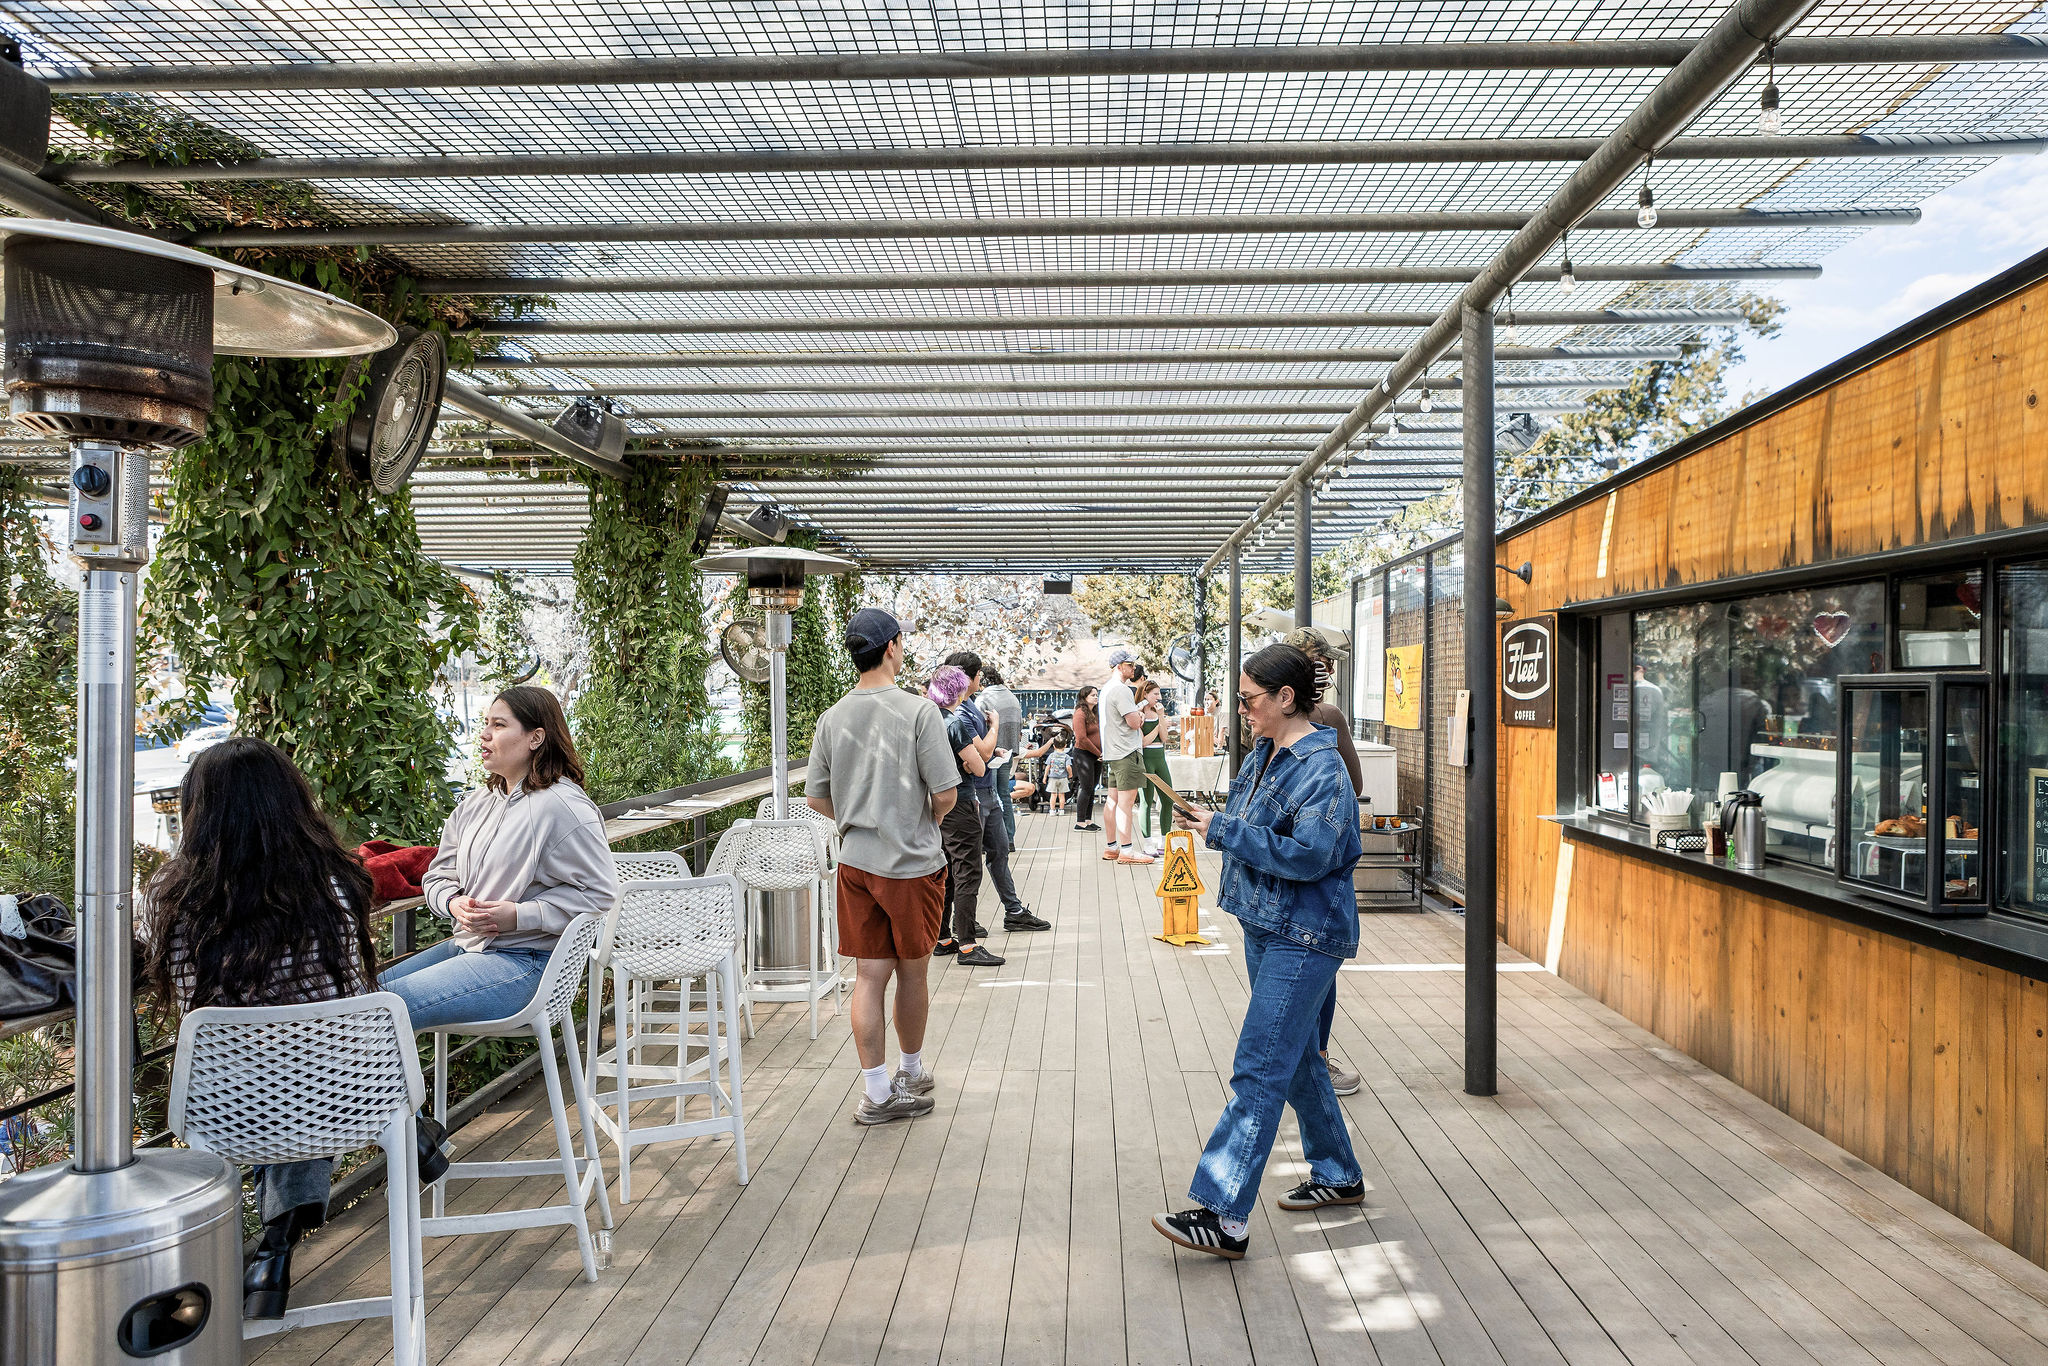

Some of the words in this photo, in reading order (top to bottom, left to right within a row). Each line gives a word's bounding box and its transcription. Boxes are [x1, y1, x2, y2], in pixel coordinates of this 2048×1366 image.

[1508, 639, 1544, 683] Fleet
[1514, 710, 1536, 721] COFFEE
[1165, 863, 1177, 883] CAUTION
[1183, 863, 1196, 883] CUIDADO
